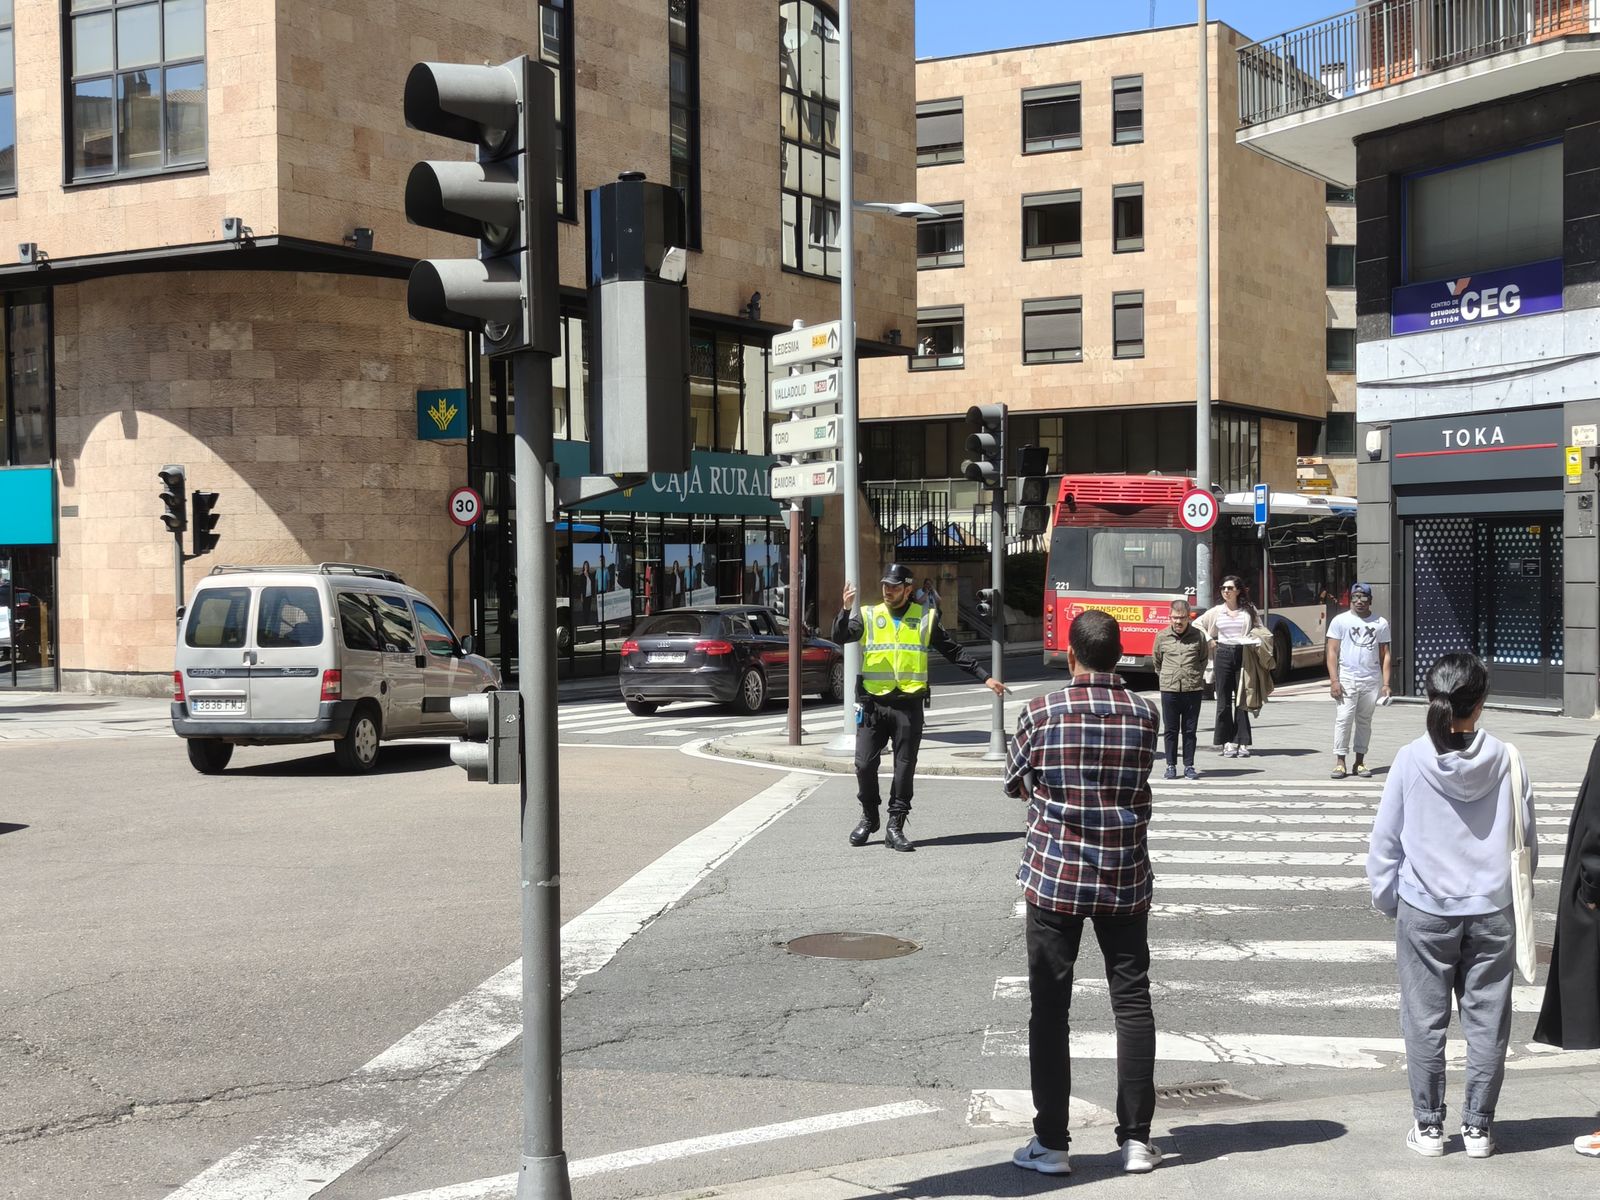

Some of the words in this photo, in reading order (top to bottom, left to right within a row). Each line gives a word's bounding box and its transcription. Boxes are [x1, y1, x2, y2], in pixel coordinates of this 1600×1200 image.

[1431, 300, 1451, 309] CENTRO
[1460, 284, 1521, 320] CEG
[1431, 308, 1459, 317] ESTUDIOS
[1431, 315, 1459, 325] GESTIÓN
[775, 340, 799, 356] LEDESMA
[775, 384, 806, 400] VALLADOLID
[775, 432, 789, 444] TORO
[1442, 426, 1504, 447] TOKA
[651, 465, 704, 502] CAJA
[774, 476, 796, 488] ZAMORA
[456, 500, 474, 512] 30
[1187, 503, 1209, 517] 30
[1056, 582, 1069, 590] 221
[1184, 587, 1197, 595] 22
[199, 699, 222, 710] 3836
